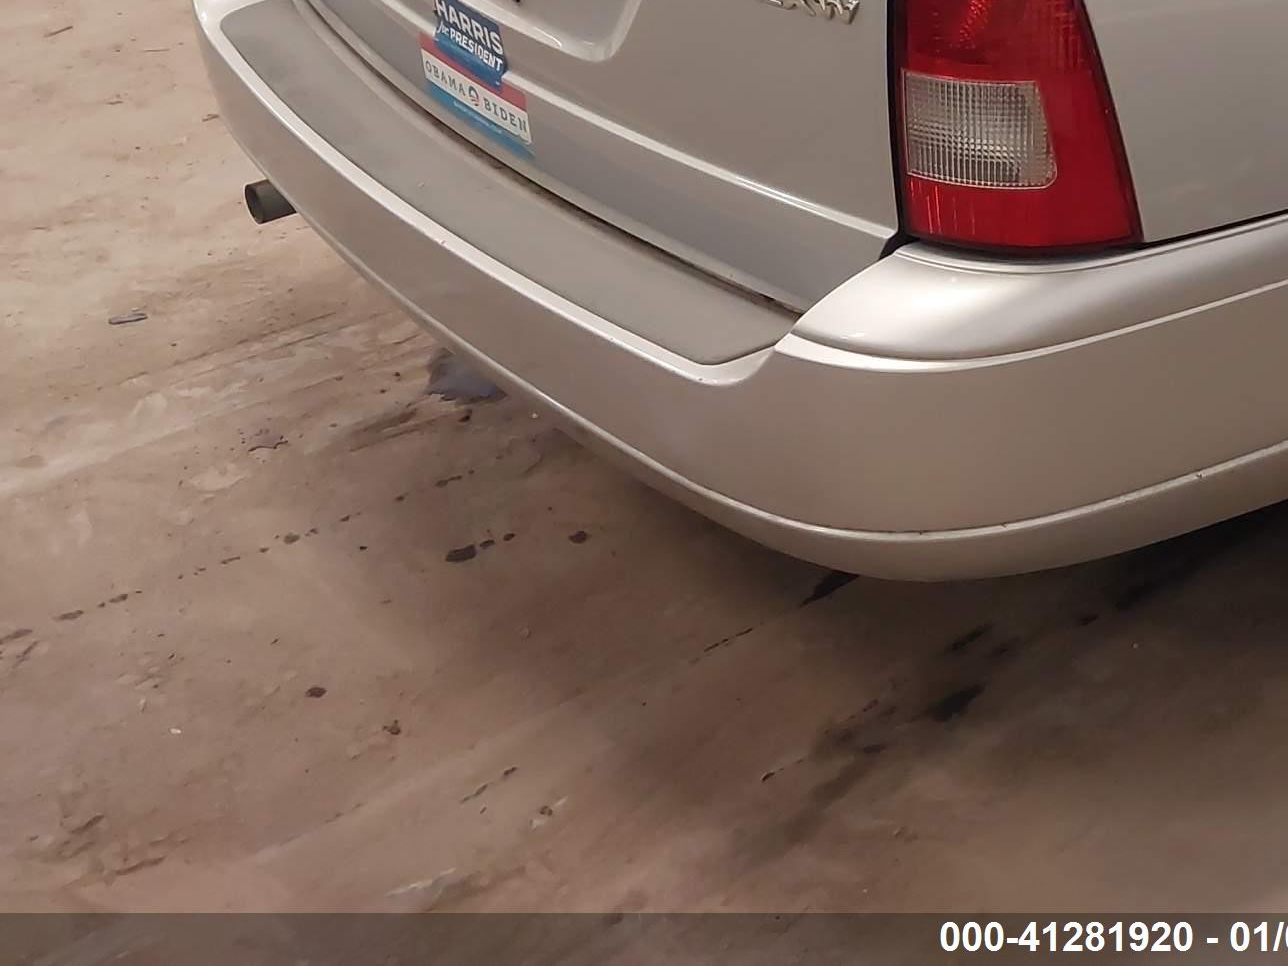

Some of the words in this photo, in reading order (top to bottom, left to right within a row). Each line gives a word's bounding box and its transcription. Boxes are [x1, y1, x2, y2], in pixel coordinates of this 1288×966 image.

[450, 29, 504, 72] PRESIDENT
[424, 59, 467, 97] OBAMA
[483, 97, 528, 133] BIDEN
